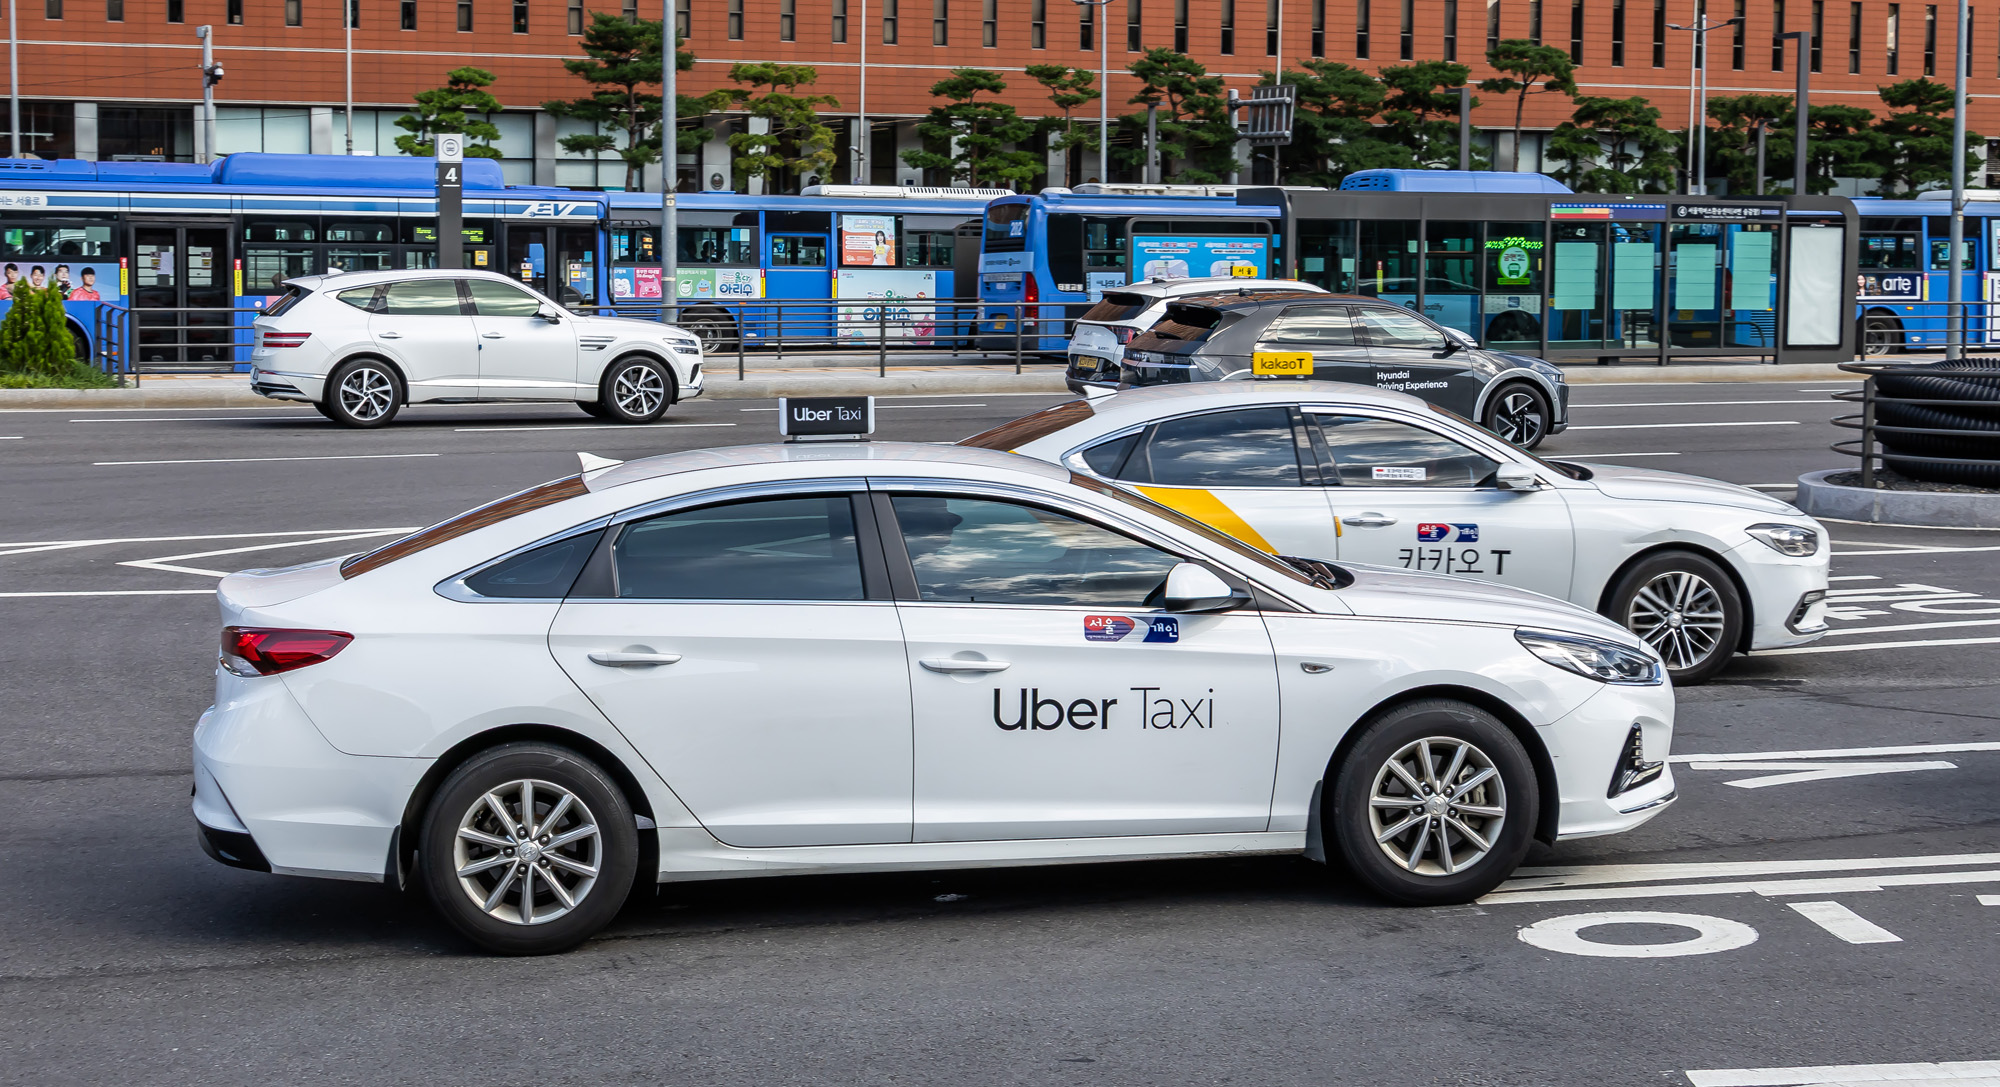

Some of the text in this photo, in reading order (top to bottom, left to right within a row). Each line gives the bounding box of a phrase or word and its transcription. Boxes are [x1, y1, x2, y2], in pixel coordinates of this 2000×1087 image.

[444, 168, 458, 183] 4
[15, 196, 41, 206] 서울로
[1010, 221, 1023, 236] 202
[1237, 267, 1252, 276] 서울
[719, 283, 753, 297] 아리수
[1882, 276, 1912, 292] arte
[1376, 370, 1410, 381] Hyundai
[1376, 380, 1449, 391] Driving Experience
[793, 406, 862, 422] Uber Taxi
[1419, 524, 1479, 539] 서울 개인
[1398, 547, 1512, 576] 카카오 T
[1089, 617, 1178, 638] 서울 개인
[992, 687, 1215, 731] Uber Taxi
